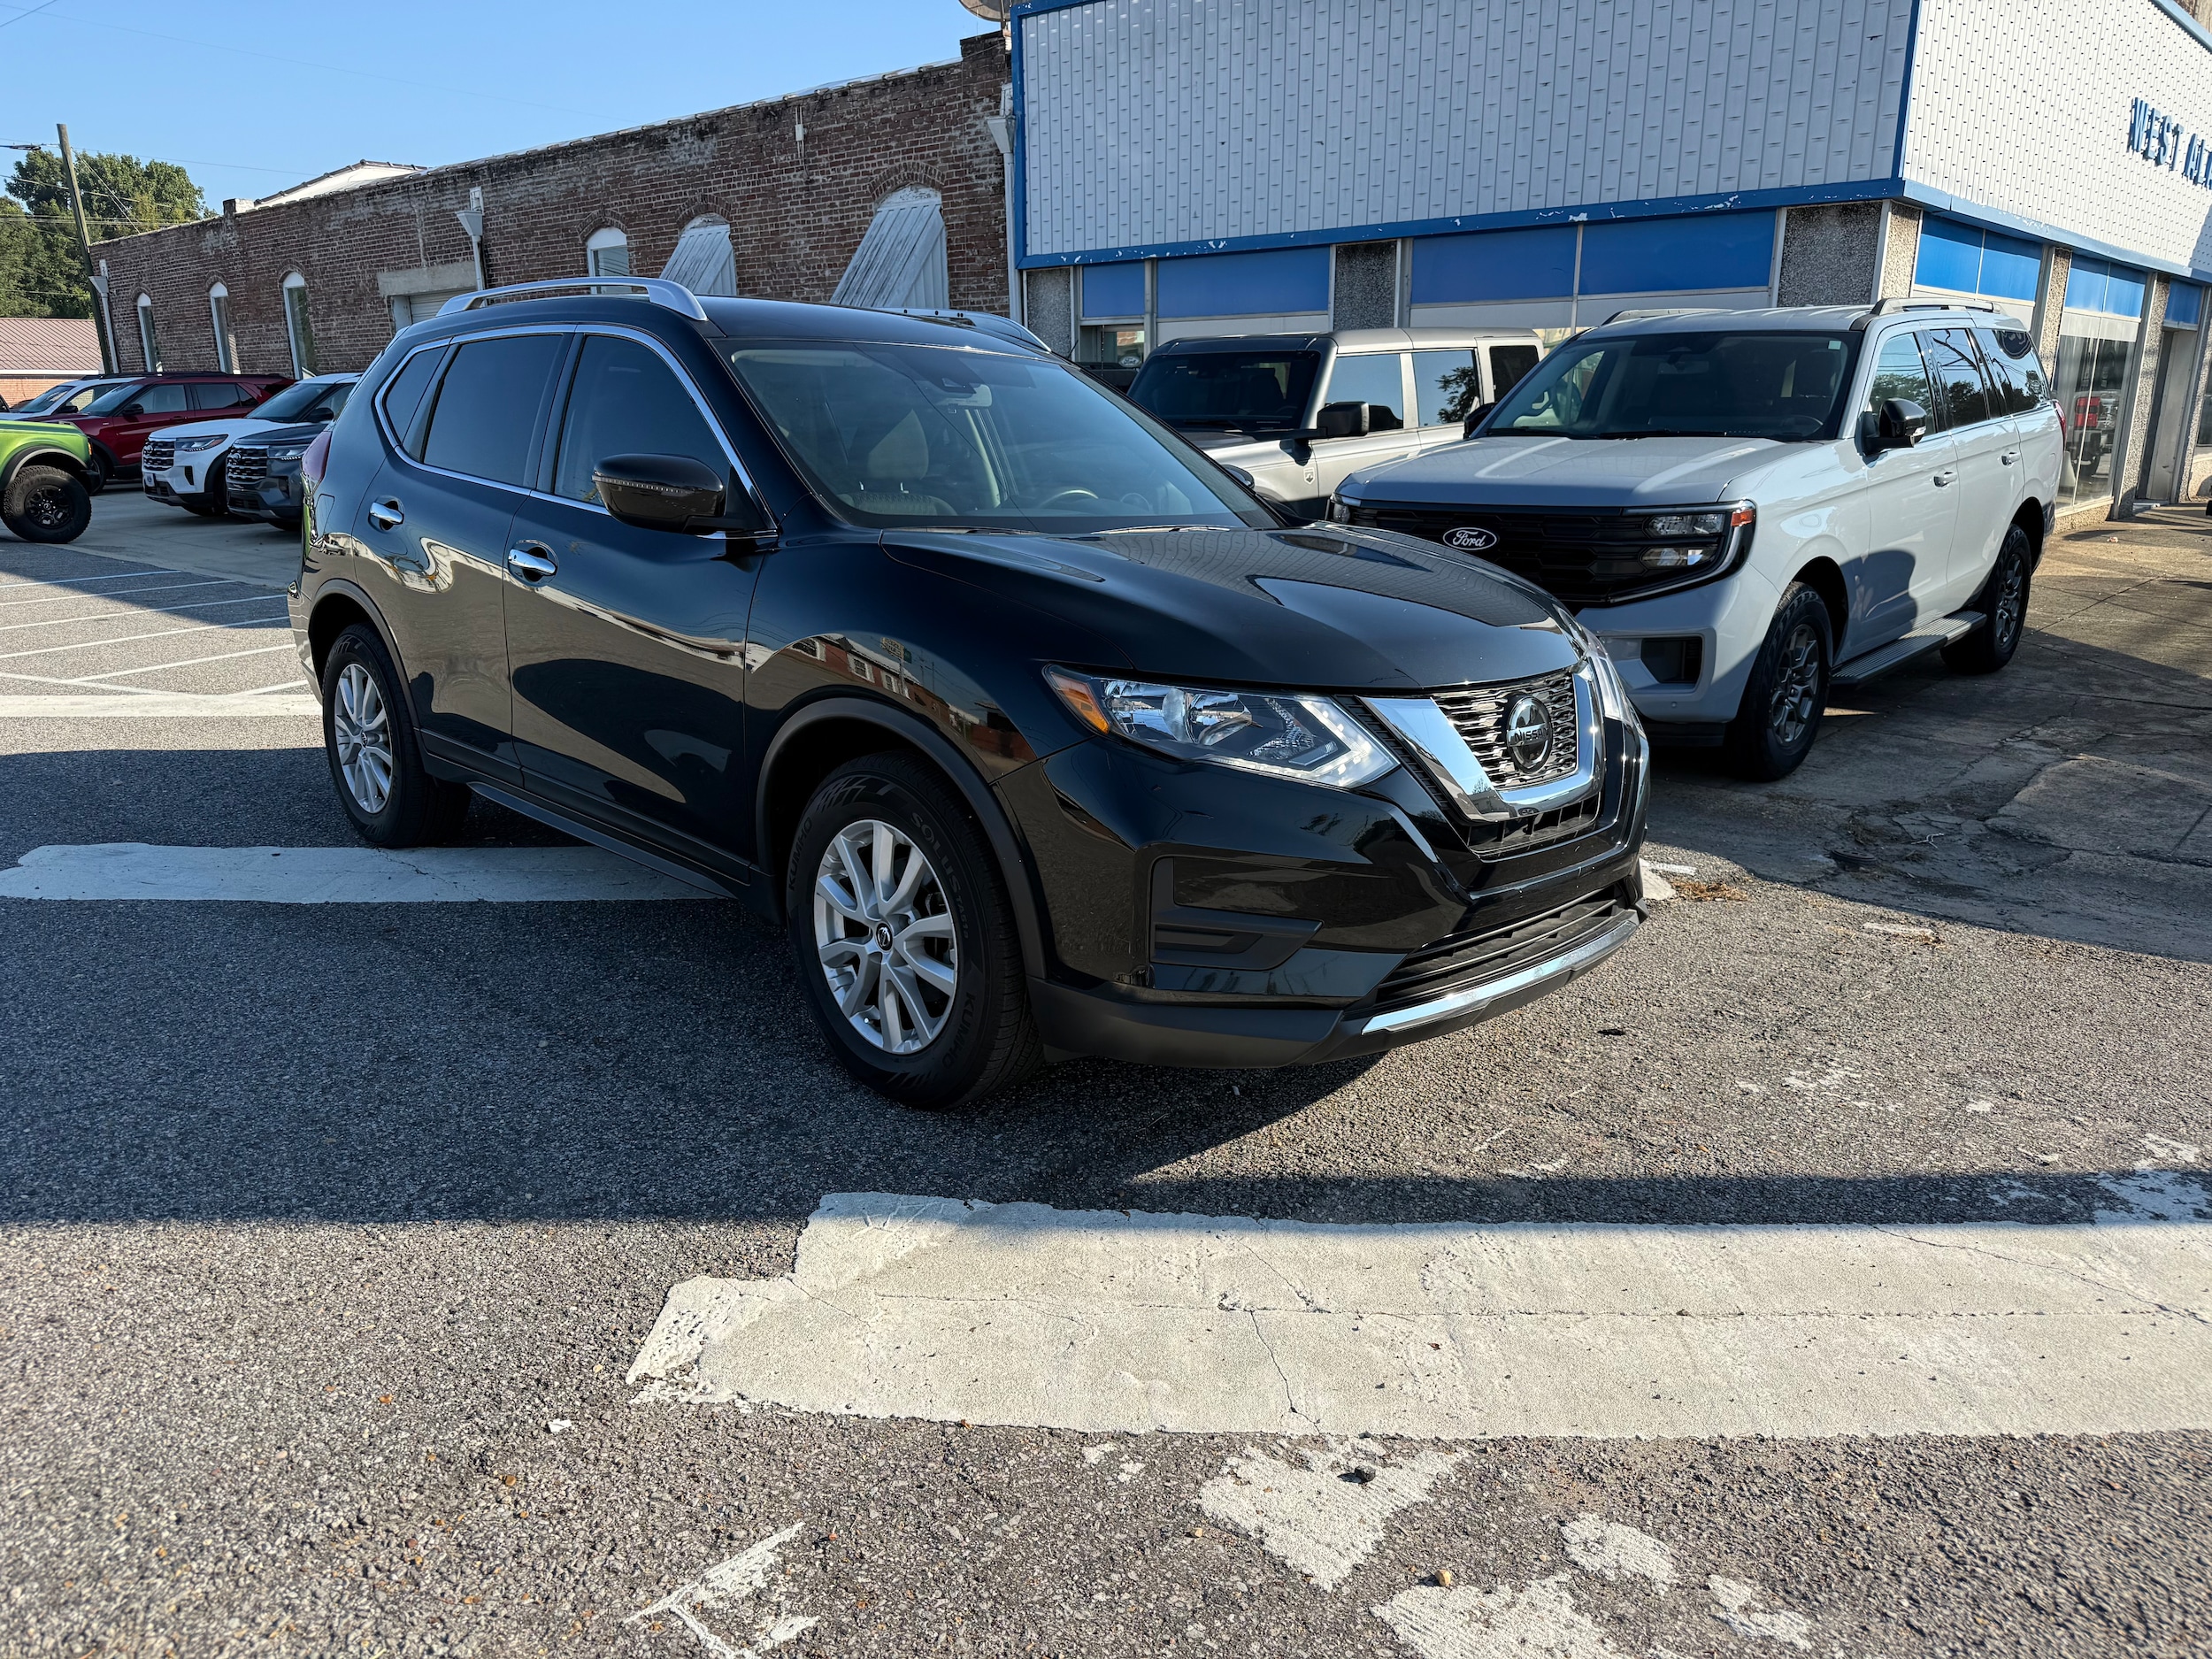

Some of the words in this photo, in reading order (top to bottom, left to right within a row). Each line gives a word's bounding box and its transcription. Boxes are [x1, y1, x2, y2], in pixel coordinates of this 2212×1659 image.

[2126, 96, 2185, 172] WEST
[1453, 530, 1486, 547] Ford
[1514, 727, 1549, 742] NISSAN
[788, 816, 812, 891] KUMHO
[910, 812, 962, 894] SOLUS
[941, 992, 976, 1069] KUMHO
